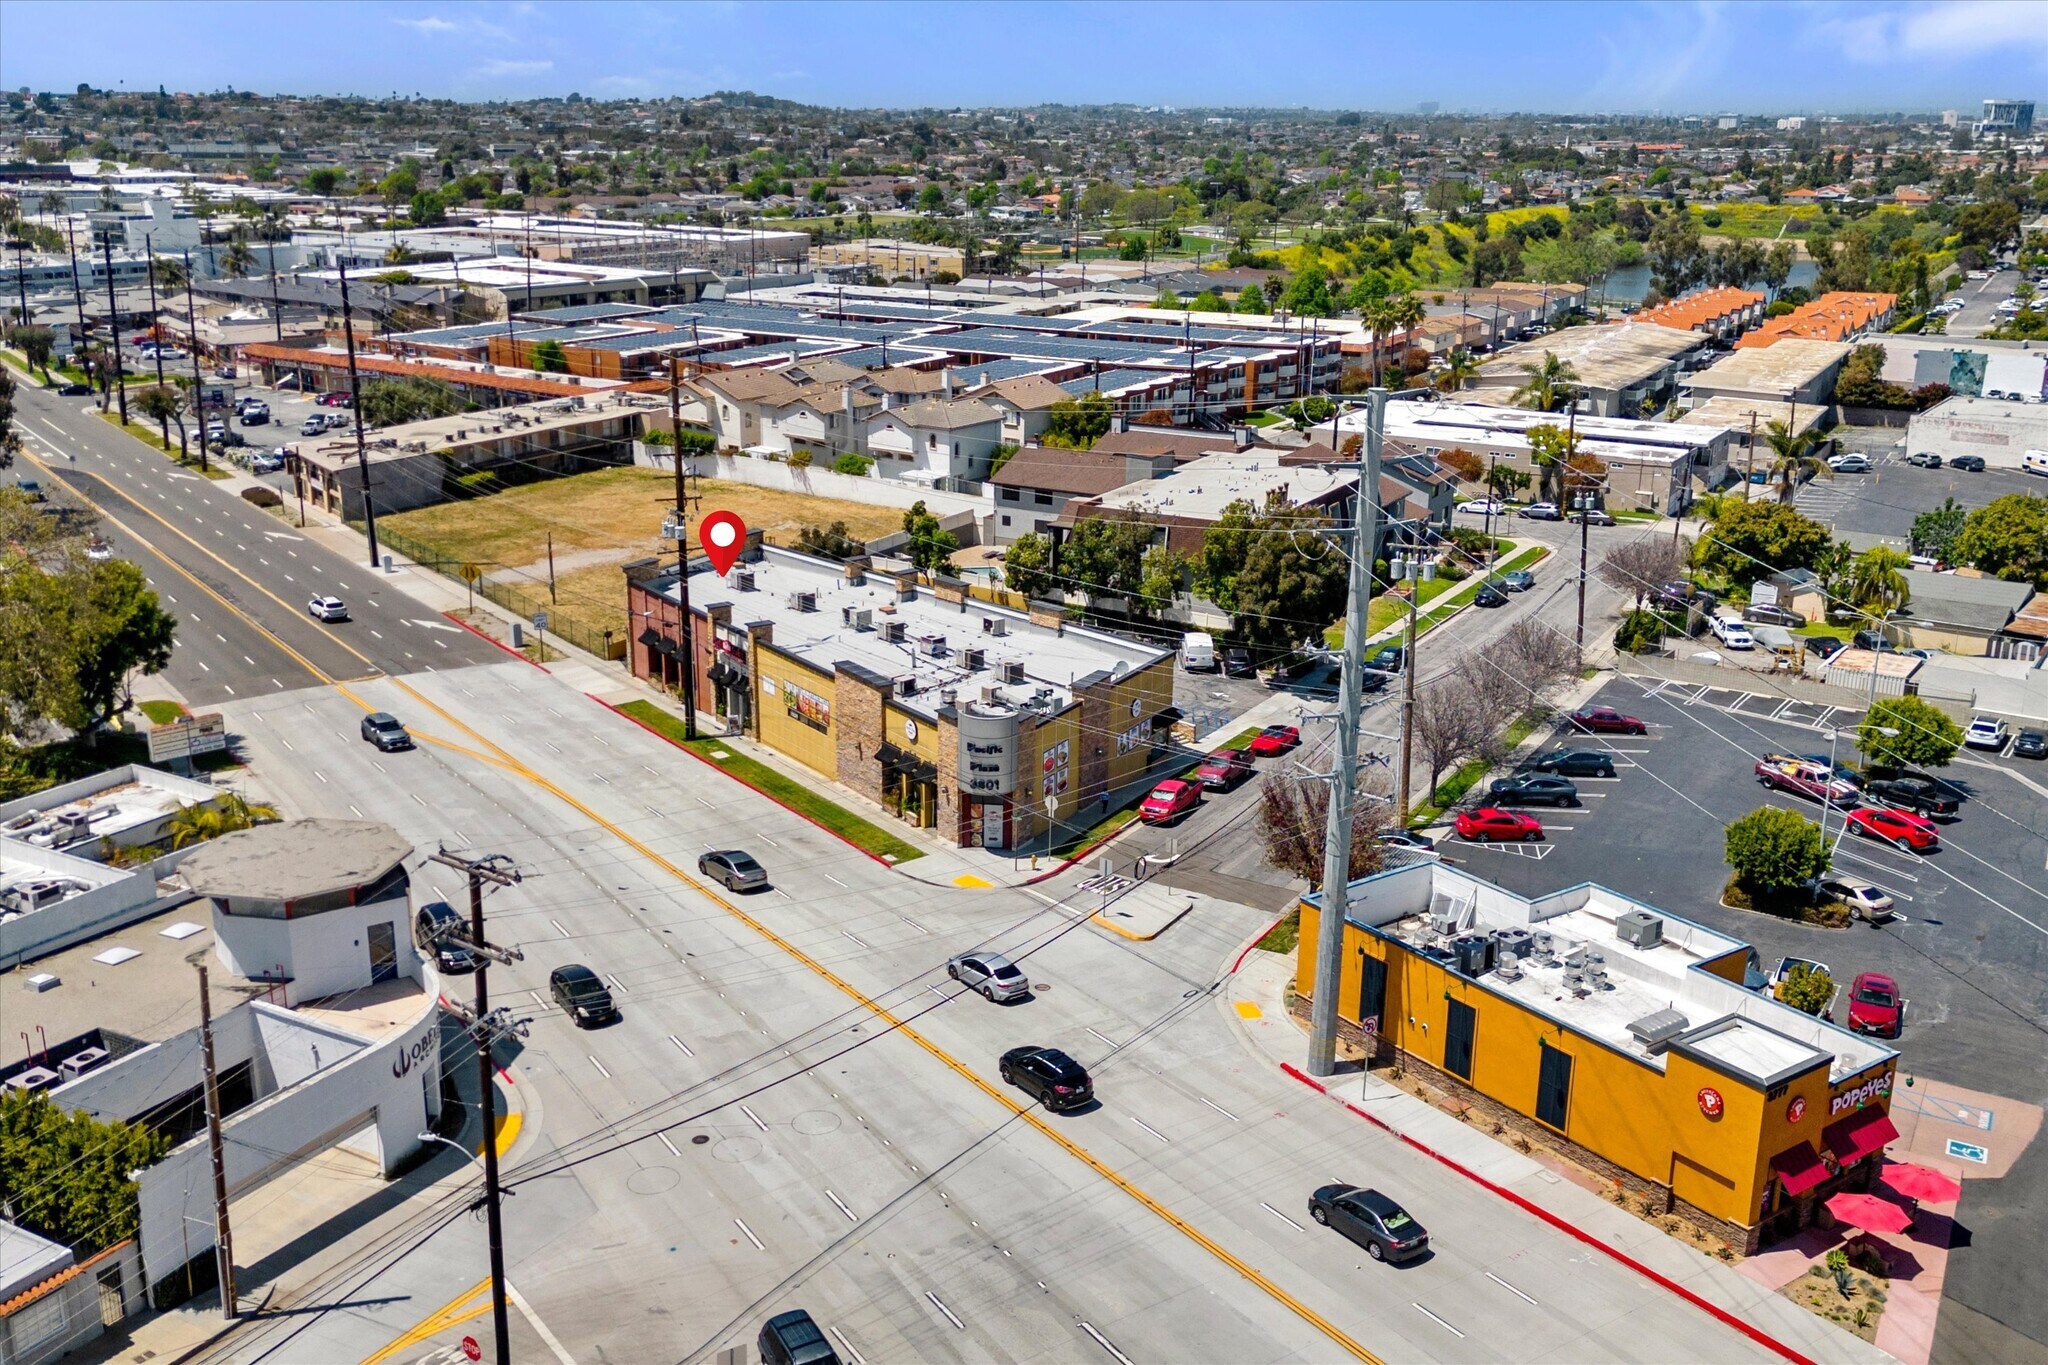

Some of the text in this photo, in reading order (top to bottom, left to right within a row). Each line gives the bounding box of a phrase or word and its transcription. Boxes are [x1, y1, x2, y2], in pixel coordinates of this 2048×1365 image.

[966, 741, 1003, 755] Pacific
[969, 761, 1000, 772] Plaza
[1704, 1094, 1716, 1108] P
[463, 1340, 481, 1356] STOP
